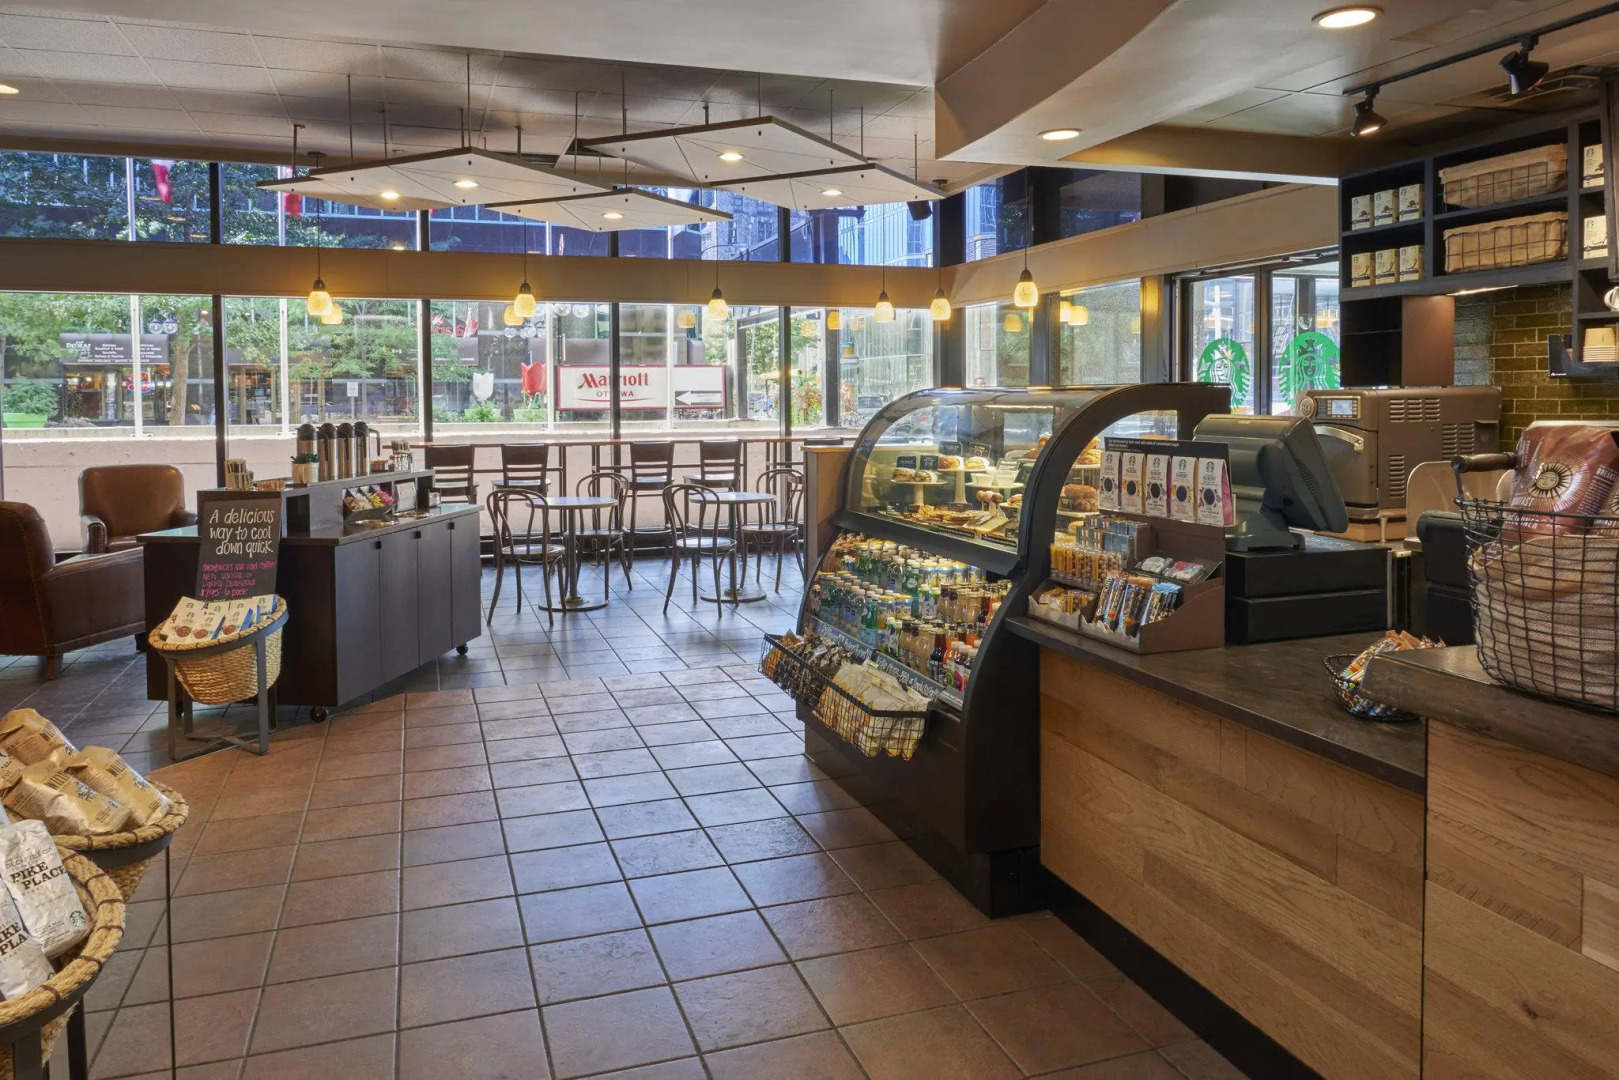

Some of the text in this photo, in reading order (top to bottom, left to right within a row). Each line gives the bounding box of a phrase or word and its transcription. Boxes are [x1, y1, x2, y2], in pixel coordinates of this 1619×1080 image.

[577, 372, 649, 389] Maiott
[209, 508, 275, 524] A delicious
[210, 525, 271, 543] way to cool
[216, 541, 243, 555] down
[10, 861, 48, 883] PIKE
[0, 922, 22, 942] IKE
[0, 932, 28, 955] PLA
